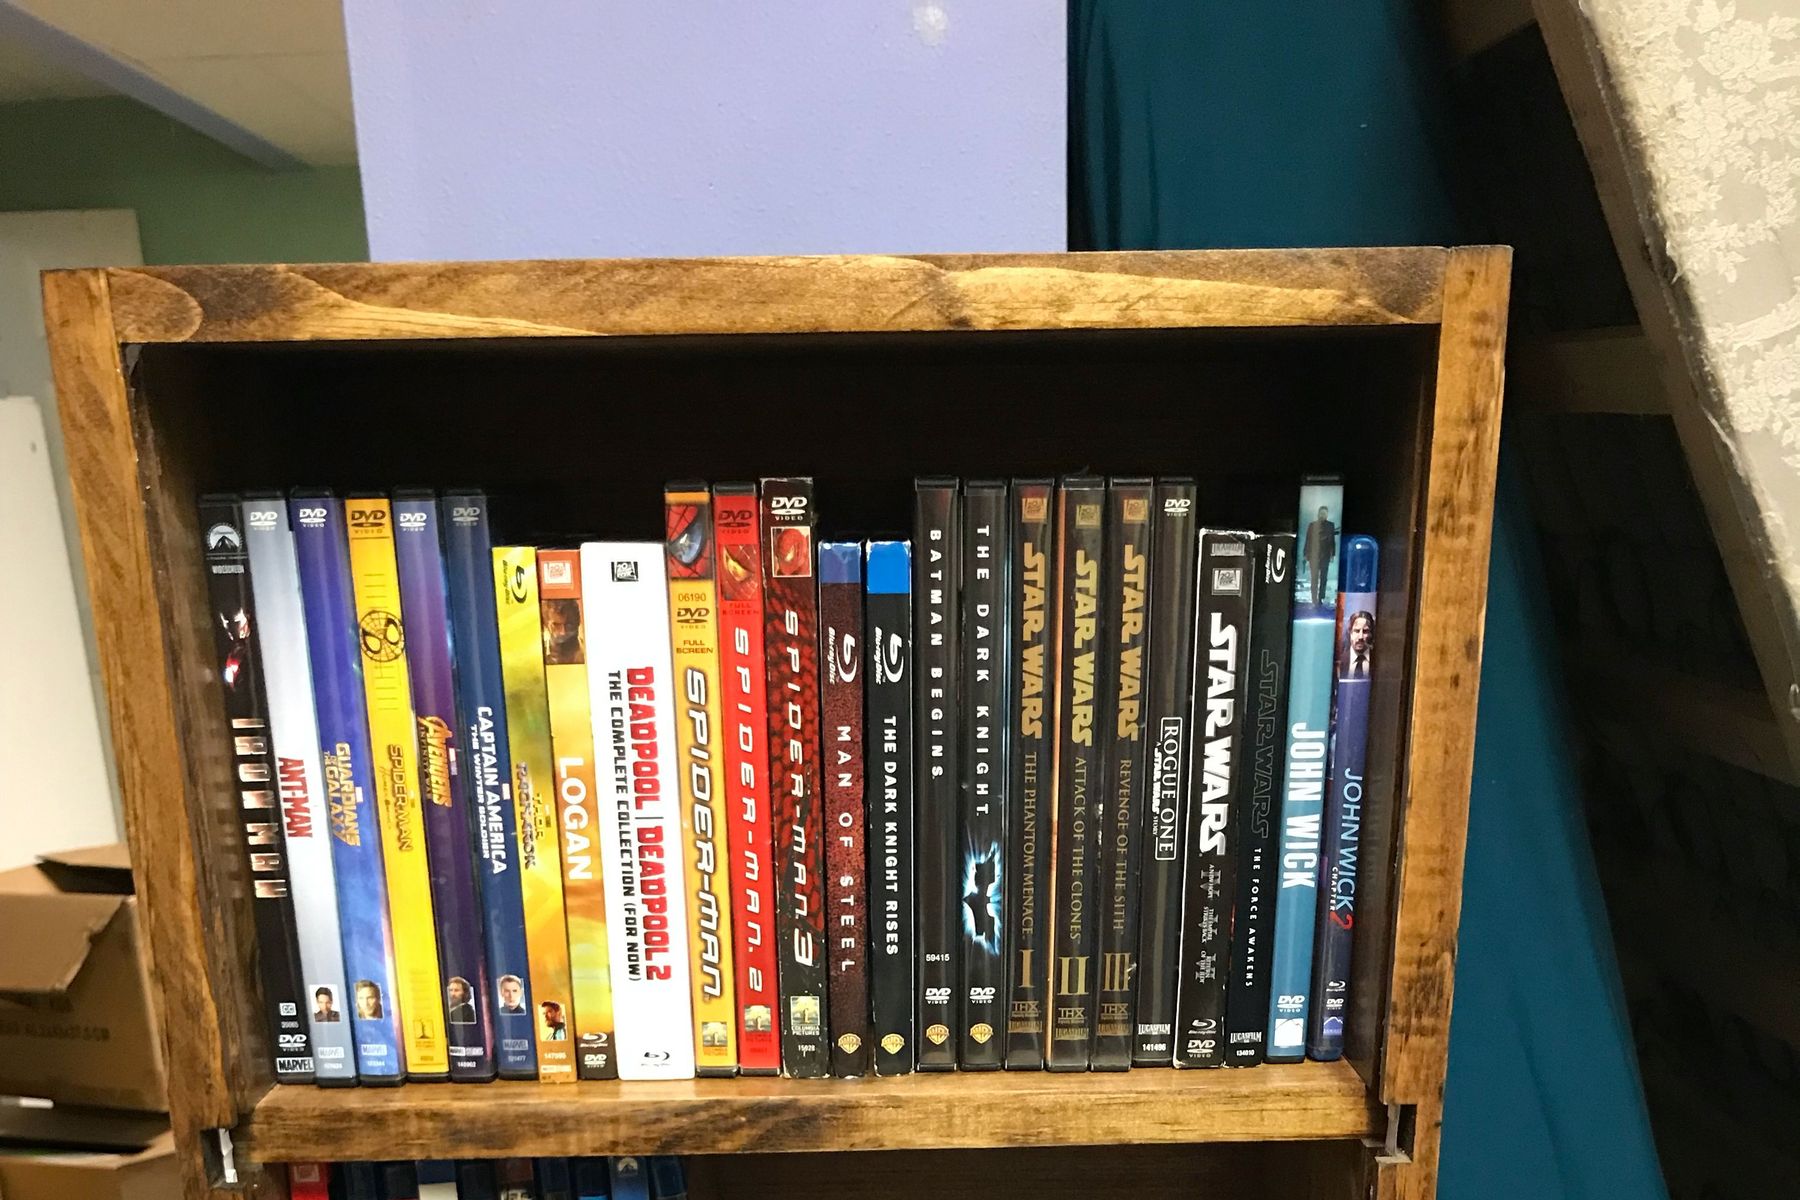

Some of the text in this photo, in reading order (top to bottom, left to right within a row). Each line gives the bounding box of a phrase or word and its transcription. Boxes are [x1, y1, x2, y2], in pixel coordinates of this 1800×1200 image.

[771, 497, 807, 509] DVD
[676, 647, 713, 655] SCREEN
[678, 593, 707, 602] 06190
[930, 529, 943, 777] BATMAN BEGINS
[1021, 542, 1045, 740] STAR WARS
[1072, 550, 1097, 747] STAR WARS
[1118, 544, 1145, 741] STAR WARS
[976, 525, 989, 815] THE DARK KNIGHT
[1200, 612, 1237, 856] STAR WARS
[232, 718, 287, 898] IRON MAN
[327, 764, 347, 839] GALAXY
[336, 742, 360, 846] GUARDIANS
[388, 744, 412, 850] SPIDER-MAN
[418, 716, 452, 807] AVENGERS
[473, 753, 490, 858] WINTER SOLDIER
[477, 707, 507, 874] CAPTAIN AMERICA
[559, 757, 592, 880] LOGAN
[608, 670, 641, 981] THE COMPLETE COLLECTION (FOR NOW)
[627, 666, 671, 981] DEADPOOL DEADPOOL 2
[686, 668, 721, 997] SPIDER-MAN
[734, 627, 762, 993] SPIDER-MAN 2
[785, 609, 813, 967] SPIDER-MAN 3
[1159, 726, 1180, 852] ROGUE ONE
[1283, 722, 1326, 889] JOHN WICK
[837, 725, 856, 971] MAN OF STEEL
[883, 715, 899, 955] THE DARK KNIGHT RISES
[1022, 752, 1037, 935] THE PHANTOM MENACE
[1070, 757, 1087, 941] ATTACK OF THE CLONES
[1113, 759, 1132, 930] REVENGE OF THE SITH
[1329, 866, 1339, 911] CHAPTER
[1335, 767, 1363, 912] JOHN WICK
[925, 954, 949, 962] 59415
[1019, 949, 1034, 988] I
[1057, 956, 1089, 996] II
[1103, 953, 1132, 991] III
[1245, 848, 1262, 987] THE FORCE AWAKENS
[1329, 911, 1353, 931] 2
[277, 1057, 314, 1073] MARVEL
[1138, 1023, 1170, 1035] LUCASFILM
[1230, 1032, 1262, 1044] LUCASFILM
